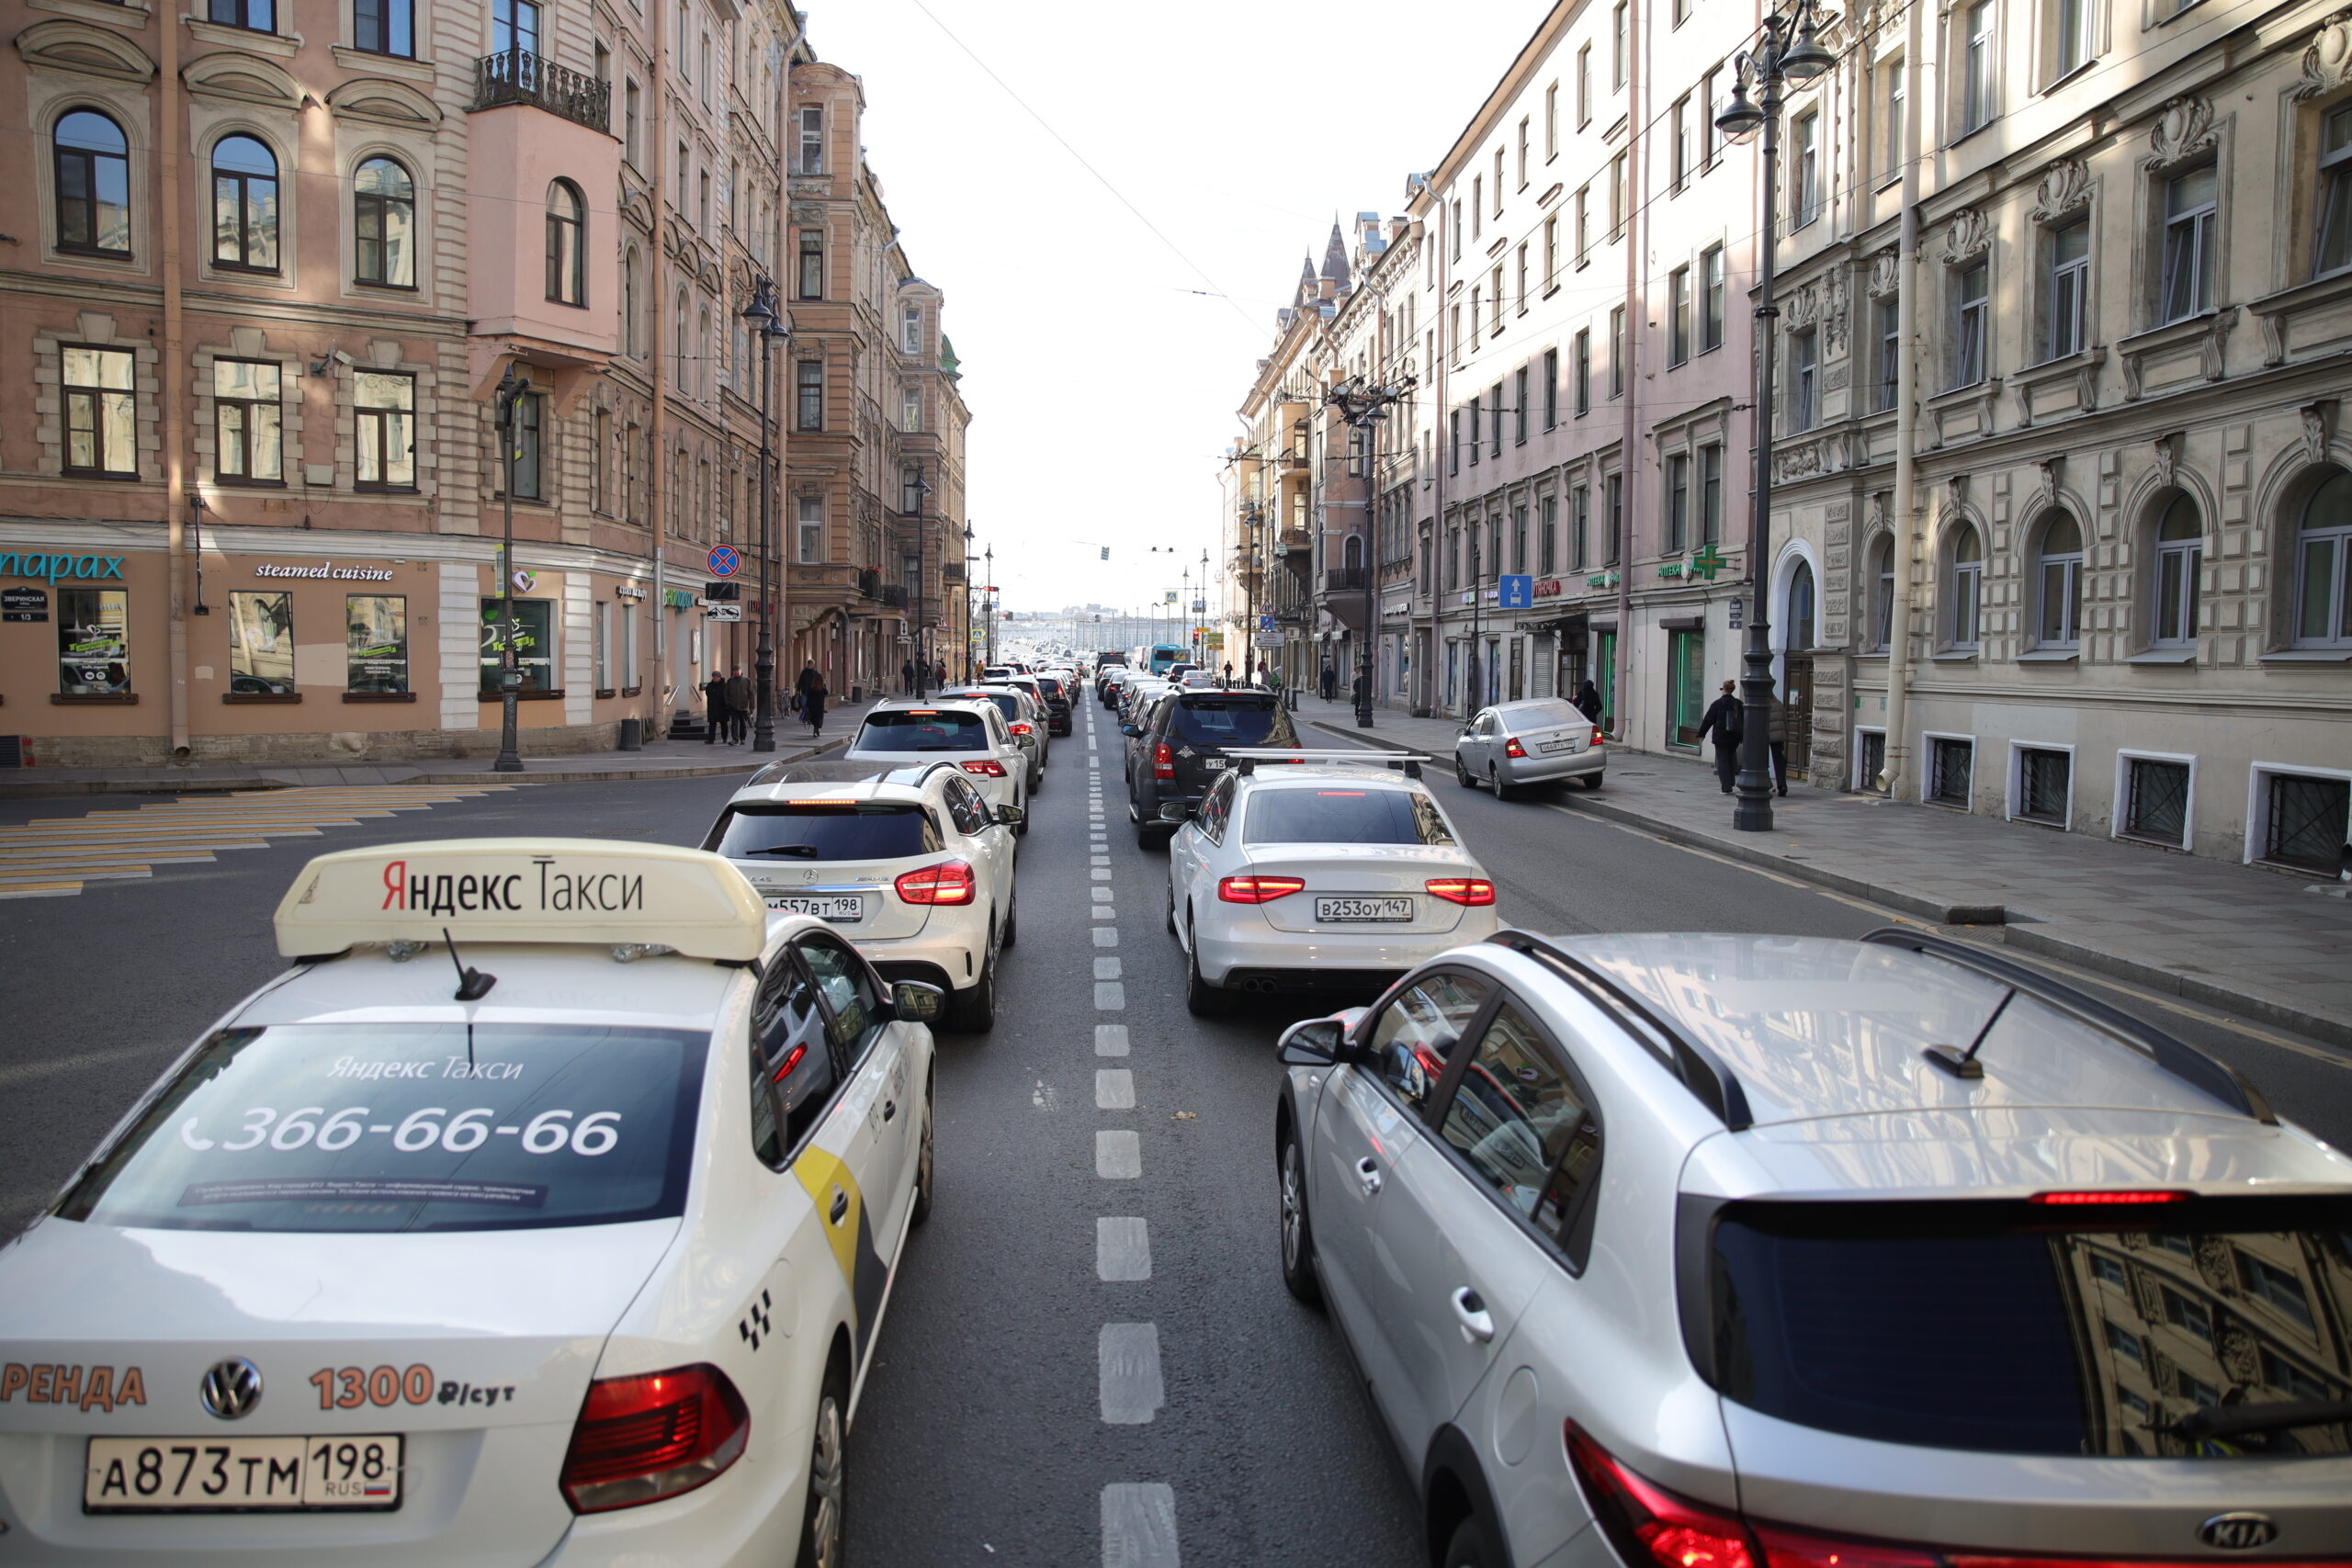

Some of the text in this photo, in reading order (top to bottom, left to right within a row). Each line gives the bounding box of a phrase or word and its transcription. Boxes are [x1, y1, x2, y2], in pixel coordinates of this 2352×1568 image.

[255, 562, 393, 581] steamed cuisine
[1657, 564, 1680, 578] АПТЕКА
[382, 861, 642, 917] Яндекс Такси
[834, 898, 857, 910] 198
[1322, 900, 1408, 916] В253ОУ 147
[326, 1055, 524, 1081] Яндекс Такси
[221, 1107, 621, 1156] 366-66-66
[0, 1362, 148, 1413] РЕНДА
[308, 1364, 435, 1410] 1300
[101, 1443, 385, 1497] А873ТМ 198
[325, 1481, 362, 1496] RUS
[2212, 1523, 2268, 1546] KIA
